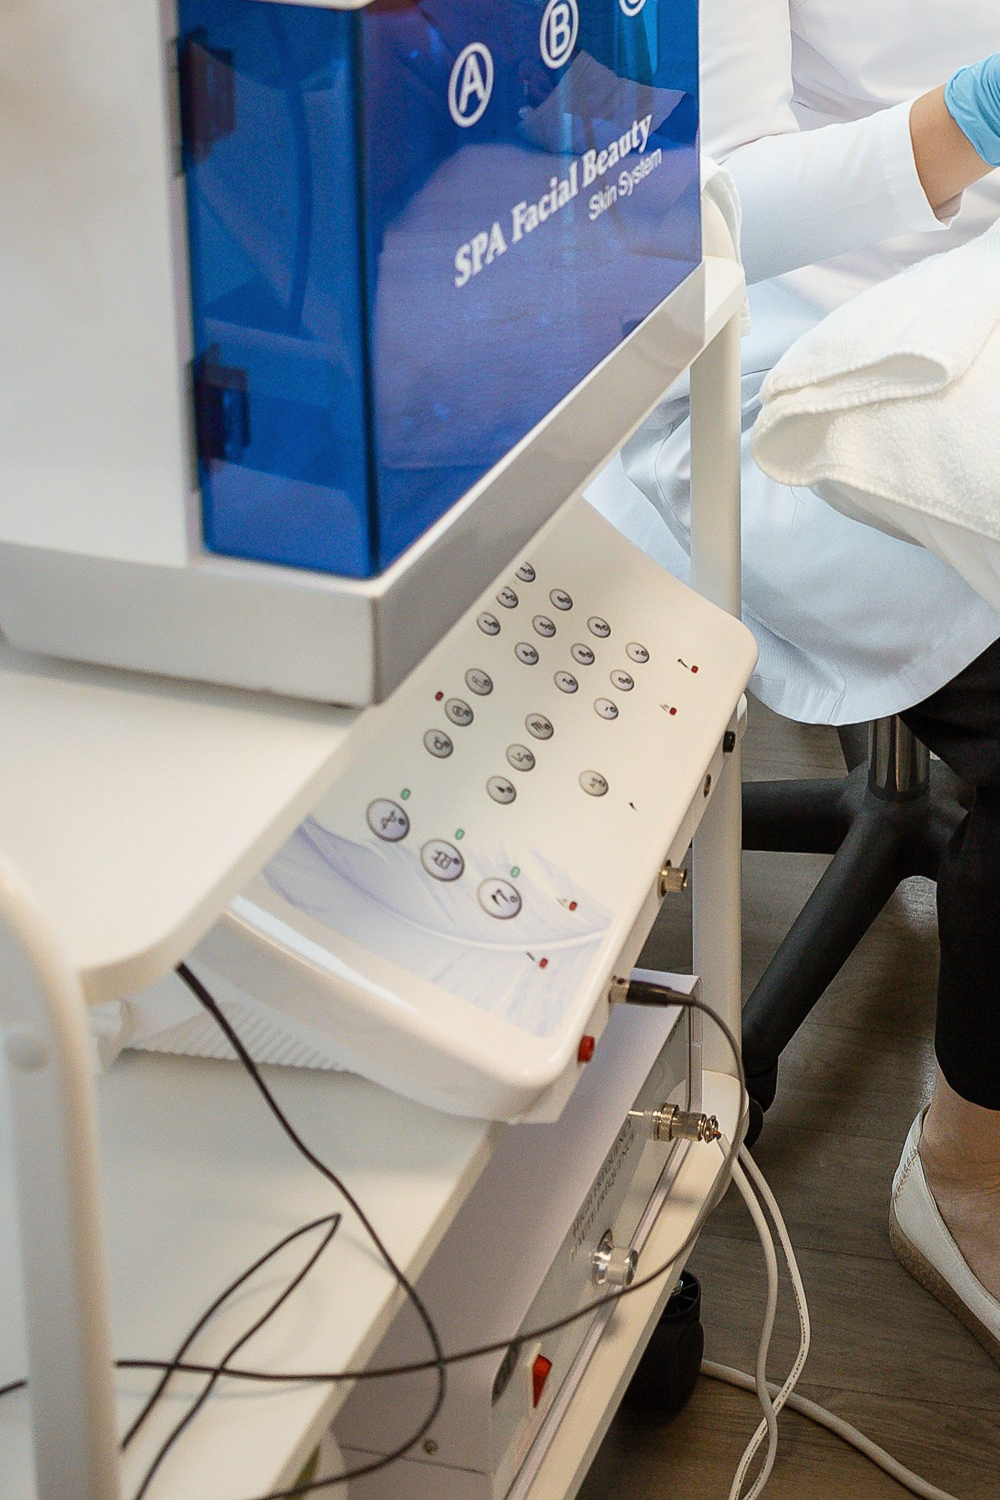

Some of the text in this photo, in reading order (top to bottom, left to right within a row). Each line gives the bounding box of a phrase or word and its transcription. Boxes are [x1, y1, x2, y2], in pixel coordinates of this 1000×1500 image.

[454, 114, 652, 288] SPA Facial Beauty
[588, 148, 663, 221] Skin System
